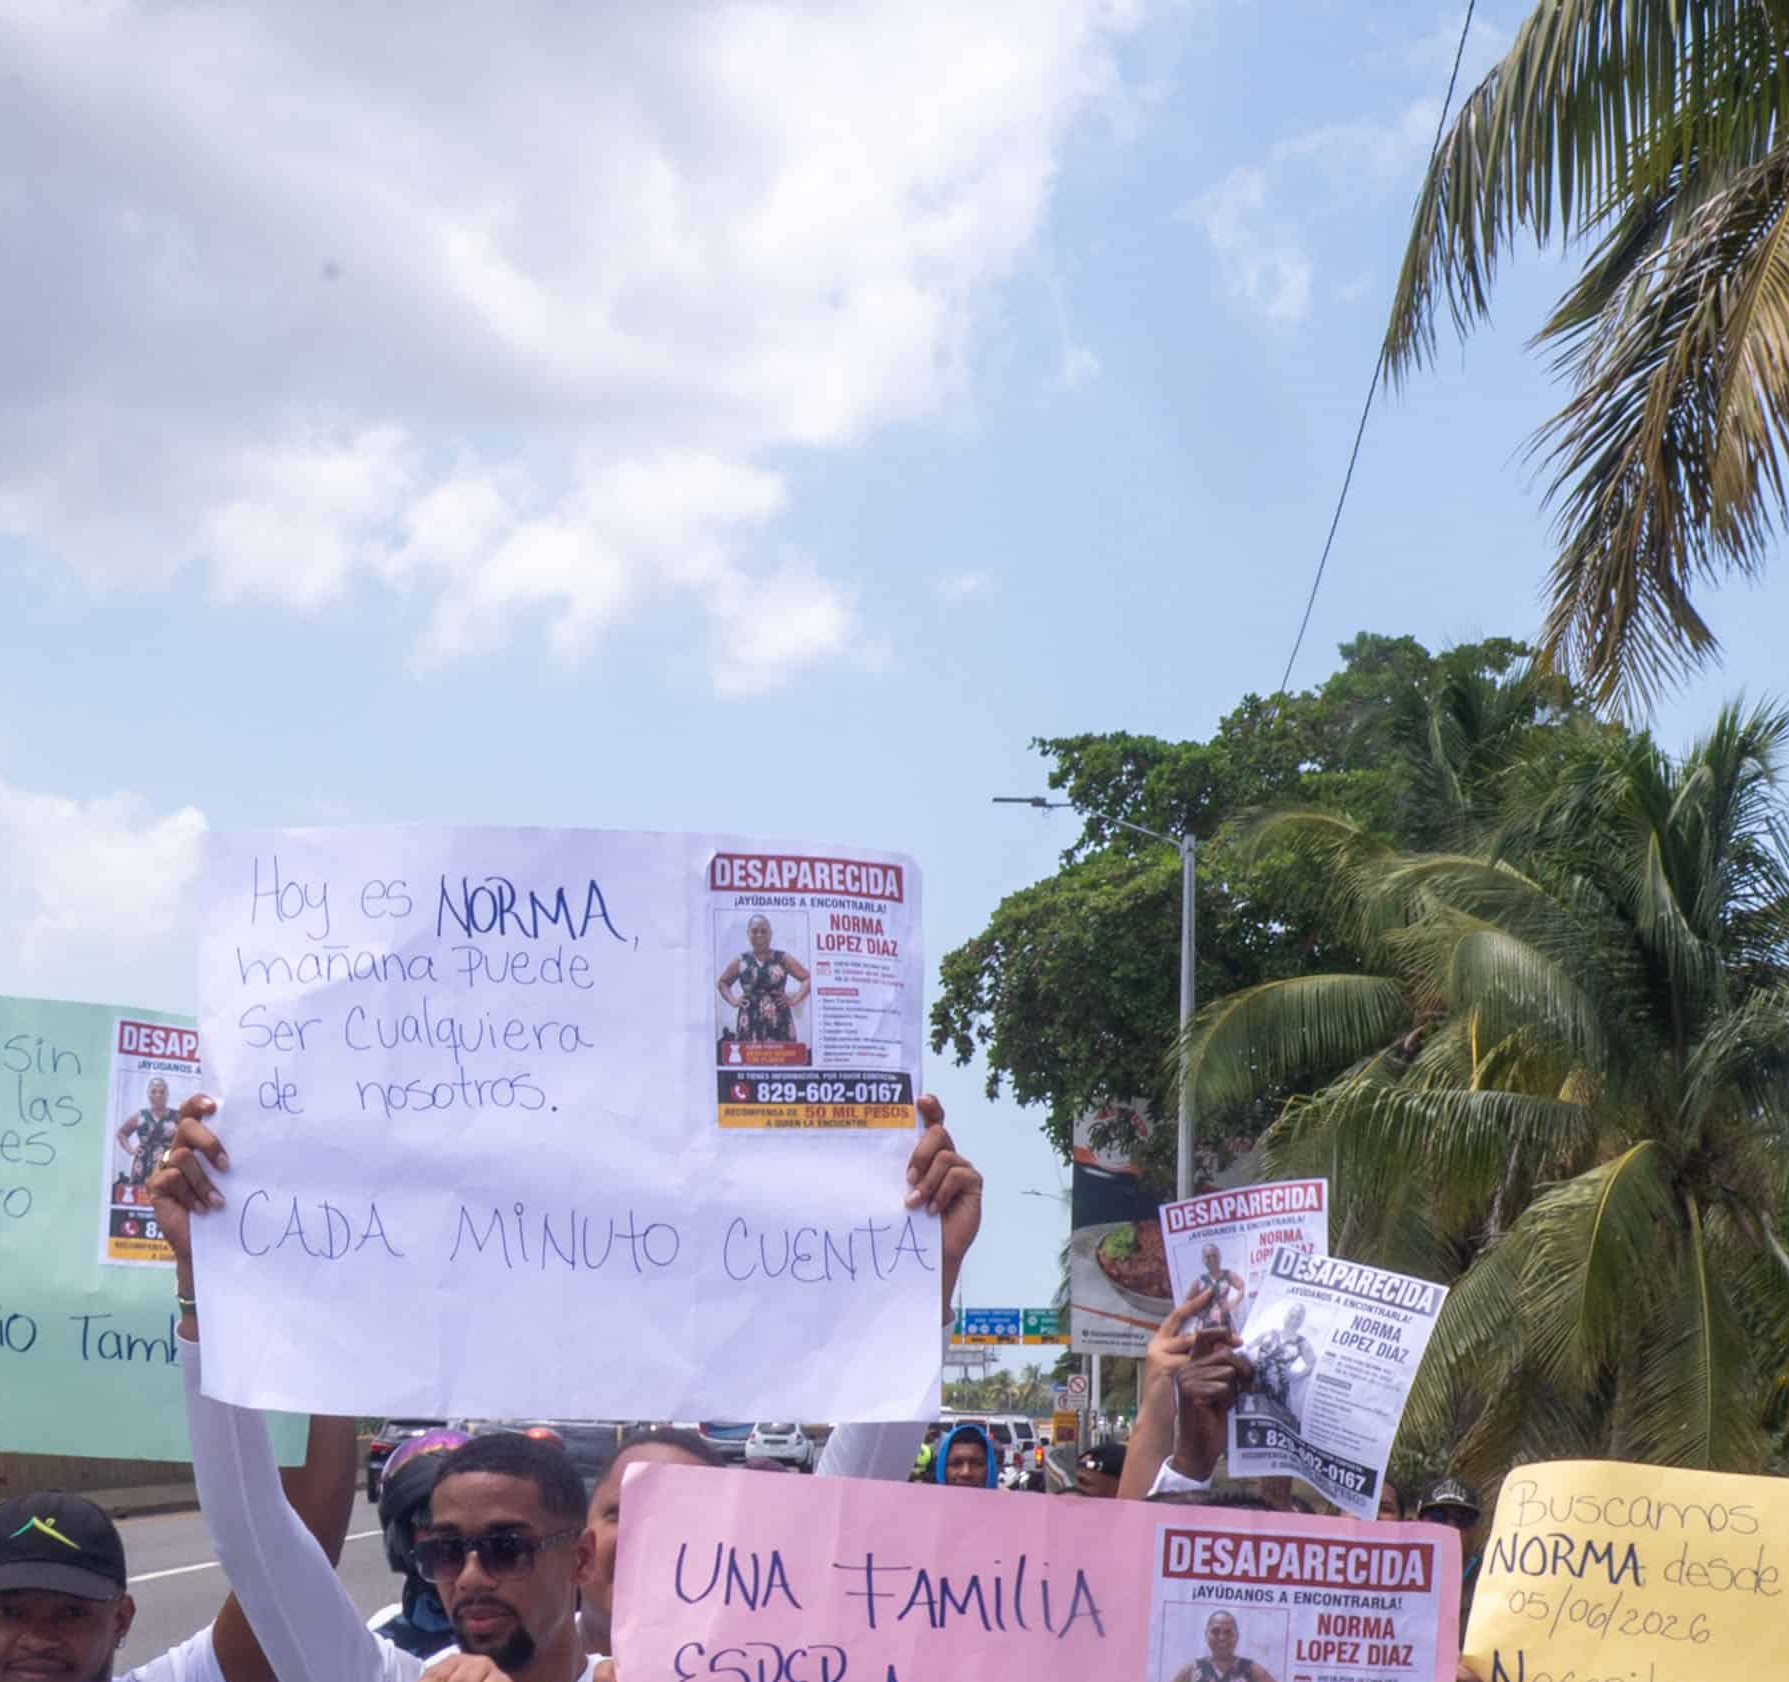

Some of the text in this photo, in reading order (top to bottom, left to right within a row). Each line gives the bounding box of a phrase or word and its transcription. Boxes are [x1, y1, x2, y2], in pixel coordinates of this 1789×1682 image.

[251, 854, 330, 941] Hoy
[361, 880, 413, 918] es
[715, 857, 900, 898] DESAPARECIDA
[800, 898, 807, 907] A
[810, 897, 887, 914] ENCONTRARLA!
[830, 913, 884, 936] NORMA
[817, 934, 899, 958] LOPEZ DIAZ
[18, 1073, 82, 1127] las
[259, 1066, 558, 1120] de nosotros.
[756, 1082, 903, 1103] 829-602-0167
[1169, 1185, 1320, 1232] DESAPARECIDA
[239, 1190, 405, 1260] CADA
[723, 1216, 936, 1283] CUENTA
[1259, 1228, 1304, 1245] NORMA
[1278, 1252, 1437, 1314] DESAPARECIDA
[1332, 1331, 1410, 1364] LOPEZ DIAZ
[1351, 1316, 1402, 1344] NORMA
[1515, 1480, 1759, 1534] Buscamos
[674, 1541, 802, 1612] UNA
[1169, 1535, 1425, 1586] DESAPARECIDA
[1663, 1541, 1782, 1597] desde
[1192, 1583, 1403, 1611] ¡AYÚDANOS A ENCONTRARLA!
[1509, 1583, 1710, 1644] 05/06/2026
[1317, 1613, 1395, 1640] NORMA
[1296, 1639, 1414, 1666] LOPEZ DIAZ
